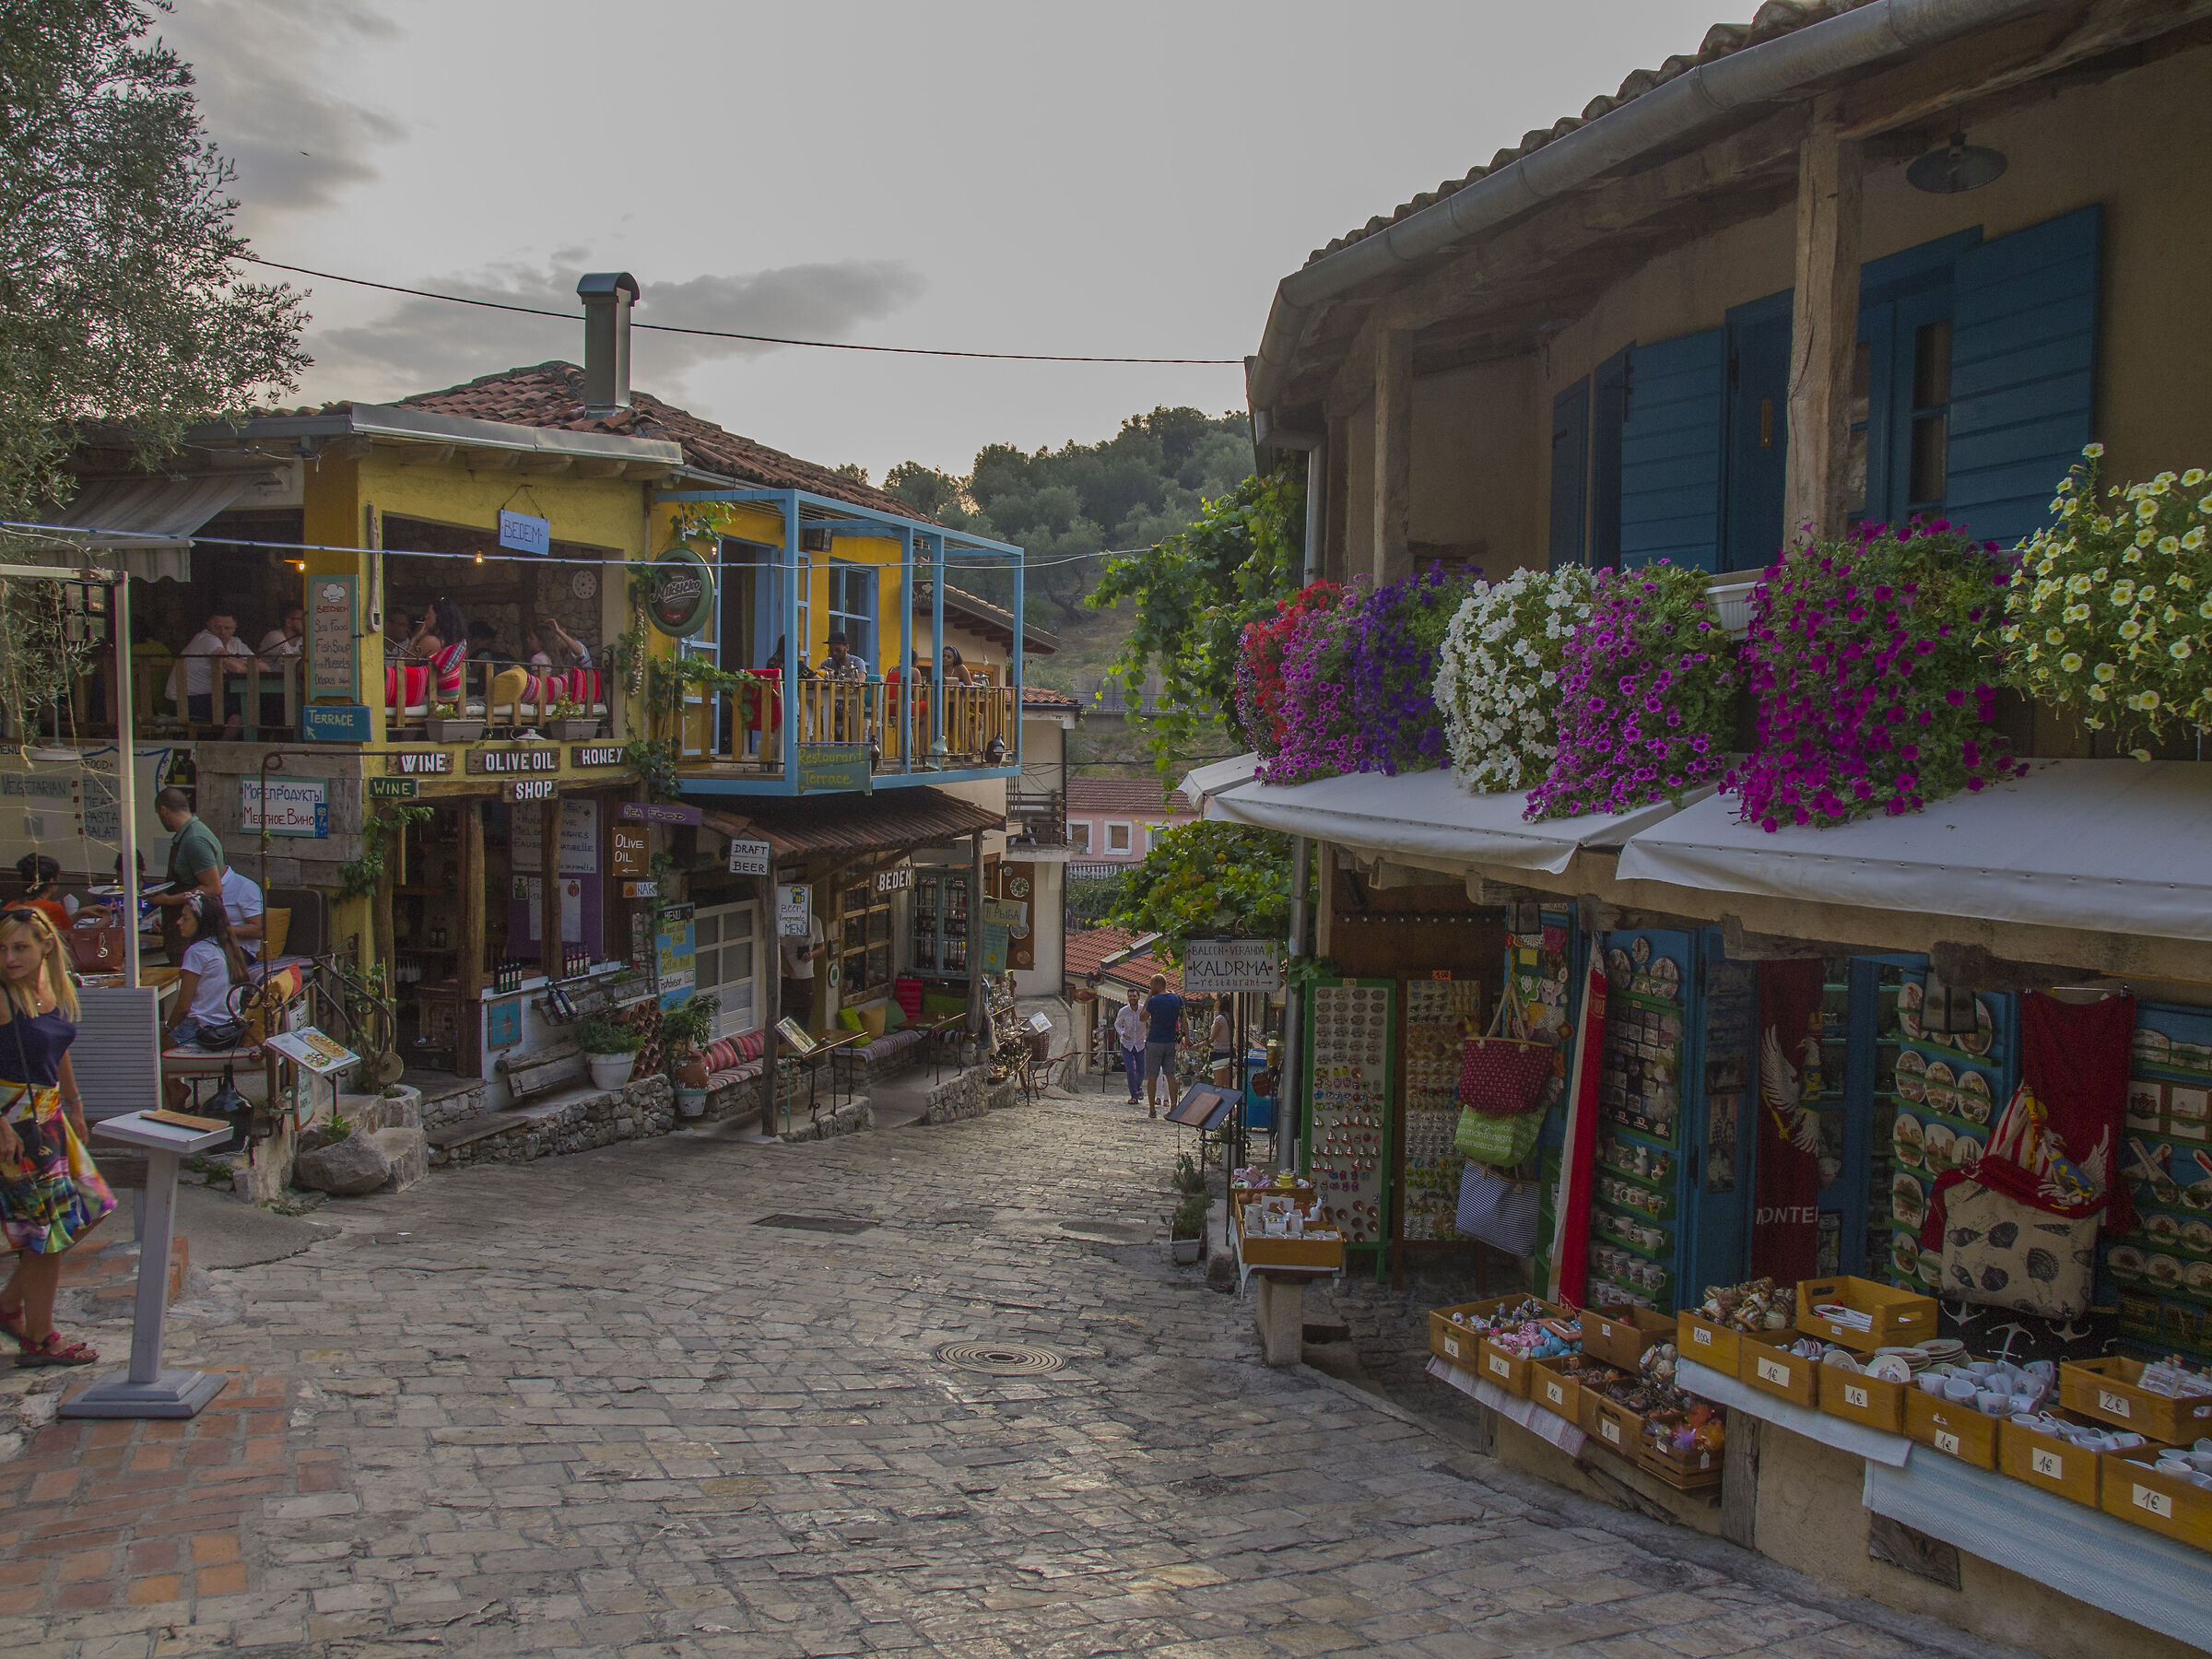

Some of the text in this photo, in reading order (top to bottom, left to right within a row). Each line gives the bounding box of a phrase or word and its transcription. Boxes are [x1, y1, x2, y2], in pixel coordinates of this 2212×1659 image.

[504, 518, 540, 544] BEDEM
[309, 710, 354, 726] TERRACE
[400, 753, 446, 772] WINE
[485, 752, 556, 771] OLIVE OIL
[582, 747, 623, 765] HONEY
[798, 747, 864, 767] Restaurant
[2, 776, 66, 795] VEGETARIAN
[800, 770, 854, 785] Terrace
[373, 781, 412, 795] WINE
[515, 781, 553, 800] SHOP
[614, 850, 634, 863] OIL
[734, 844, 768, 855] DRAFT
[733, 861, 766, 874] BEER
[878, 869, 912, 891] BEDEM
[637, 883, 656, 896] NAR
[1192, 946, 1265, 956] BALCON VERANDA
[1193, 960, 1269, 976] KALDRMA
[1200, 978, 1260, 987] restaurant
[1851, 1390, 1863, 1405] 1€
[2104, 1394, 2123, 1412] 2€
[1940, 1434, 1952, 1451] 1€
[2039, 1456, 2052, 1472] 1€
[2143, 1491, 2160, 1510] 1€
